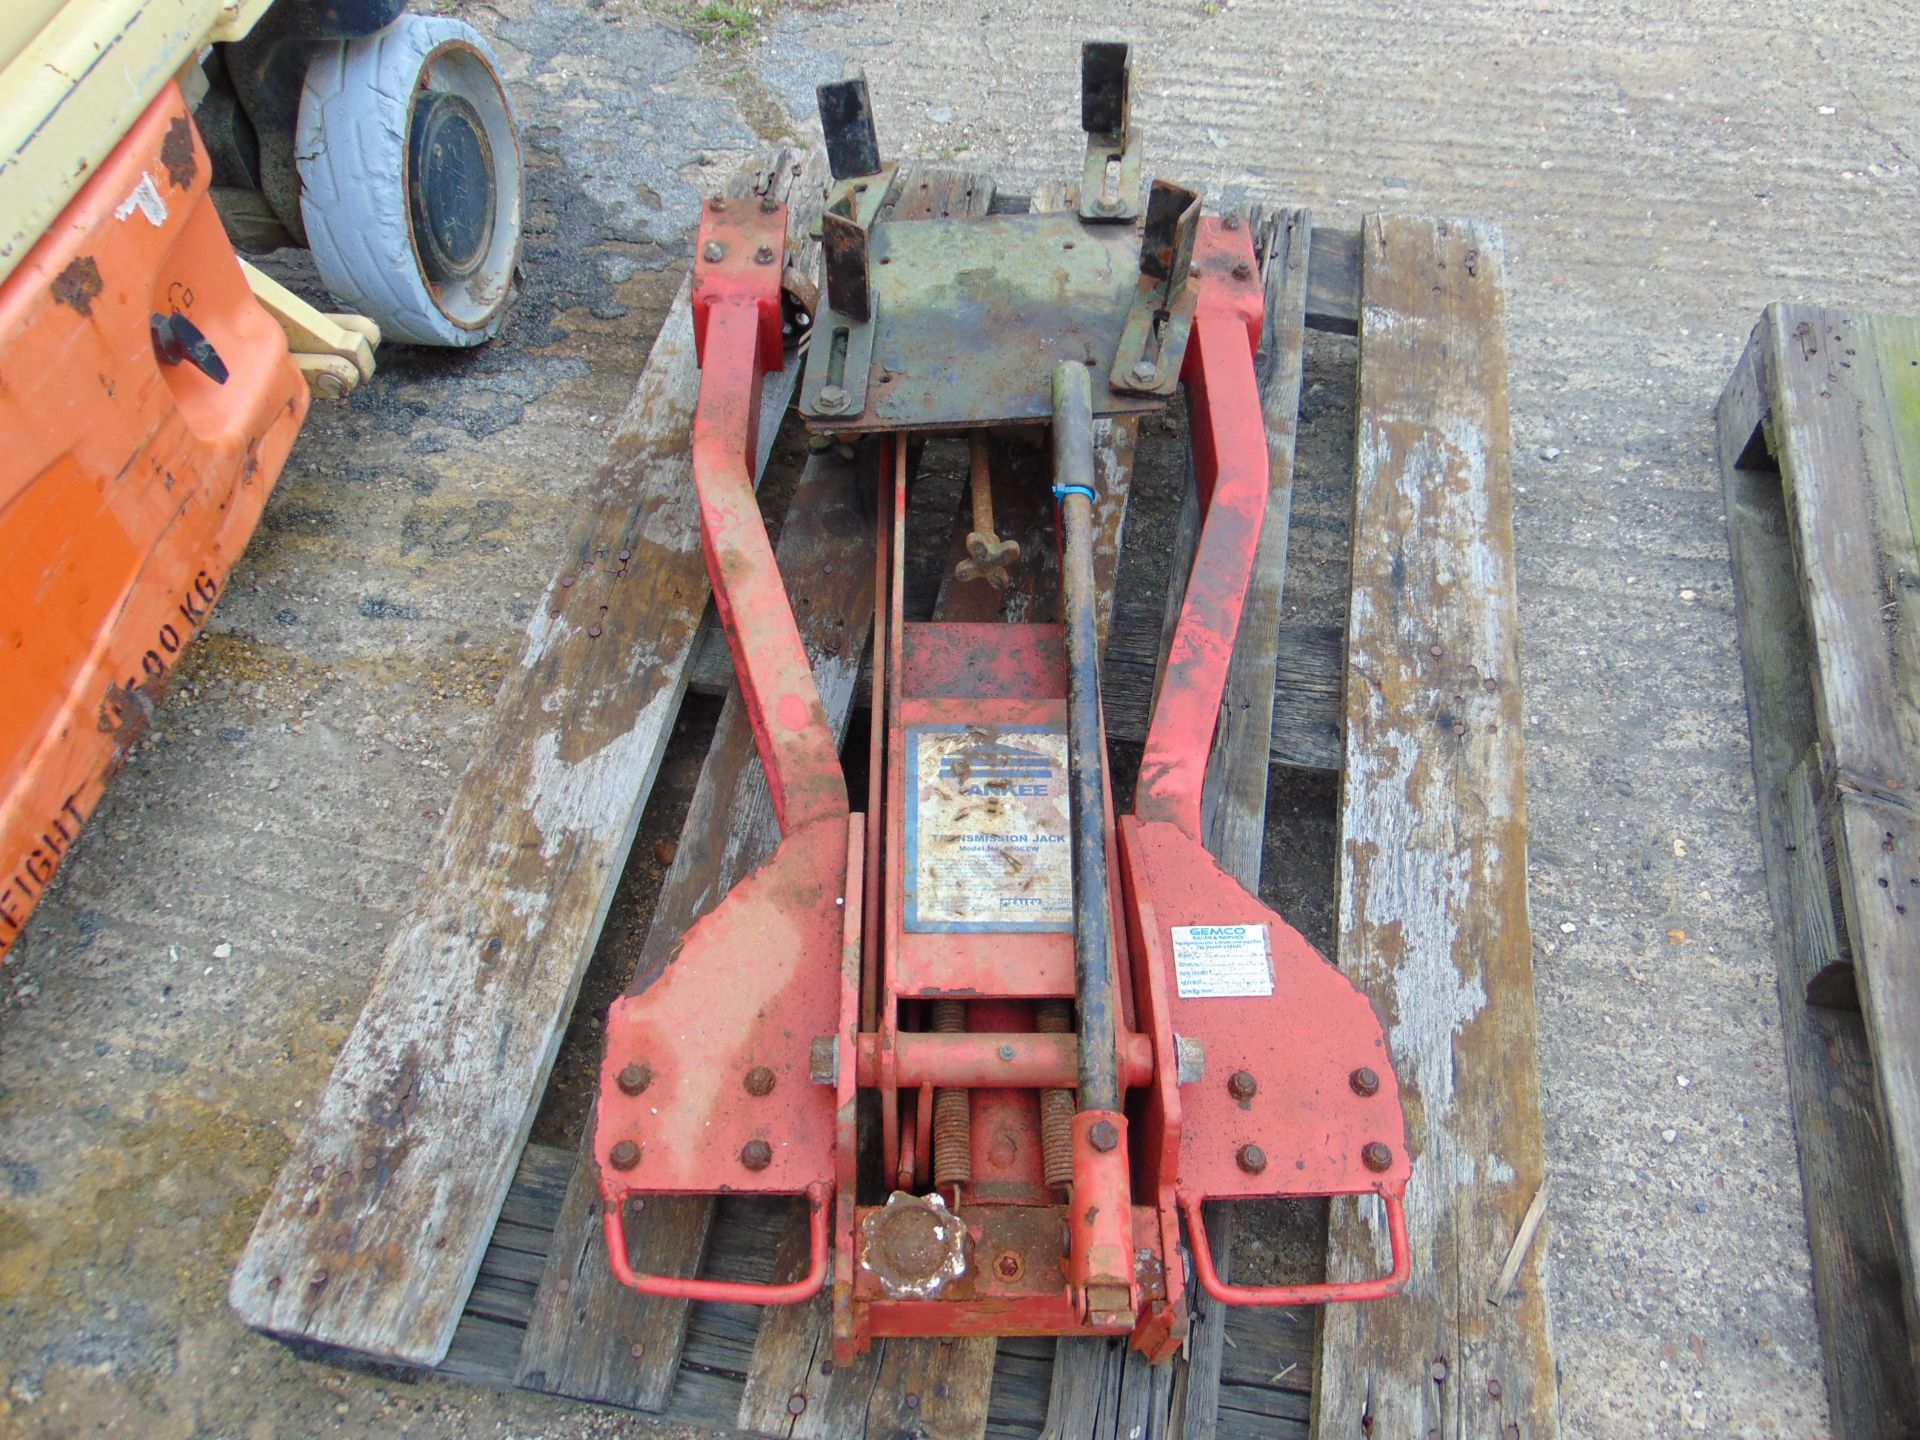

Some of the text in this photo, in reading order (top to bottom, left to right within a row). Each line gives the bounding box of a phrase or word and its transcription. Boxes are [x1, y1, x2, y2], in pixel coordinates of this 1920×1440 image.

[0, 782, 88, 948] EIGHT
[179, 570, 217, 627] KG
[1032, 834, 1066, 843] JACK
[1189, 927, 1246, 936] GEMCO
